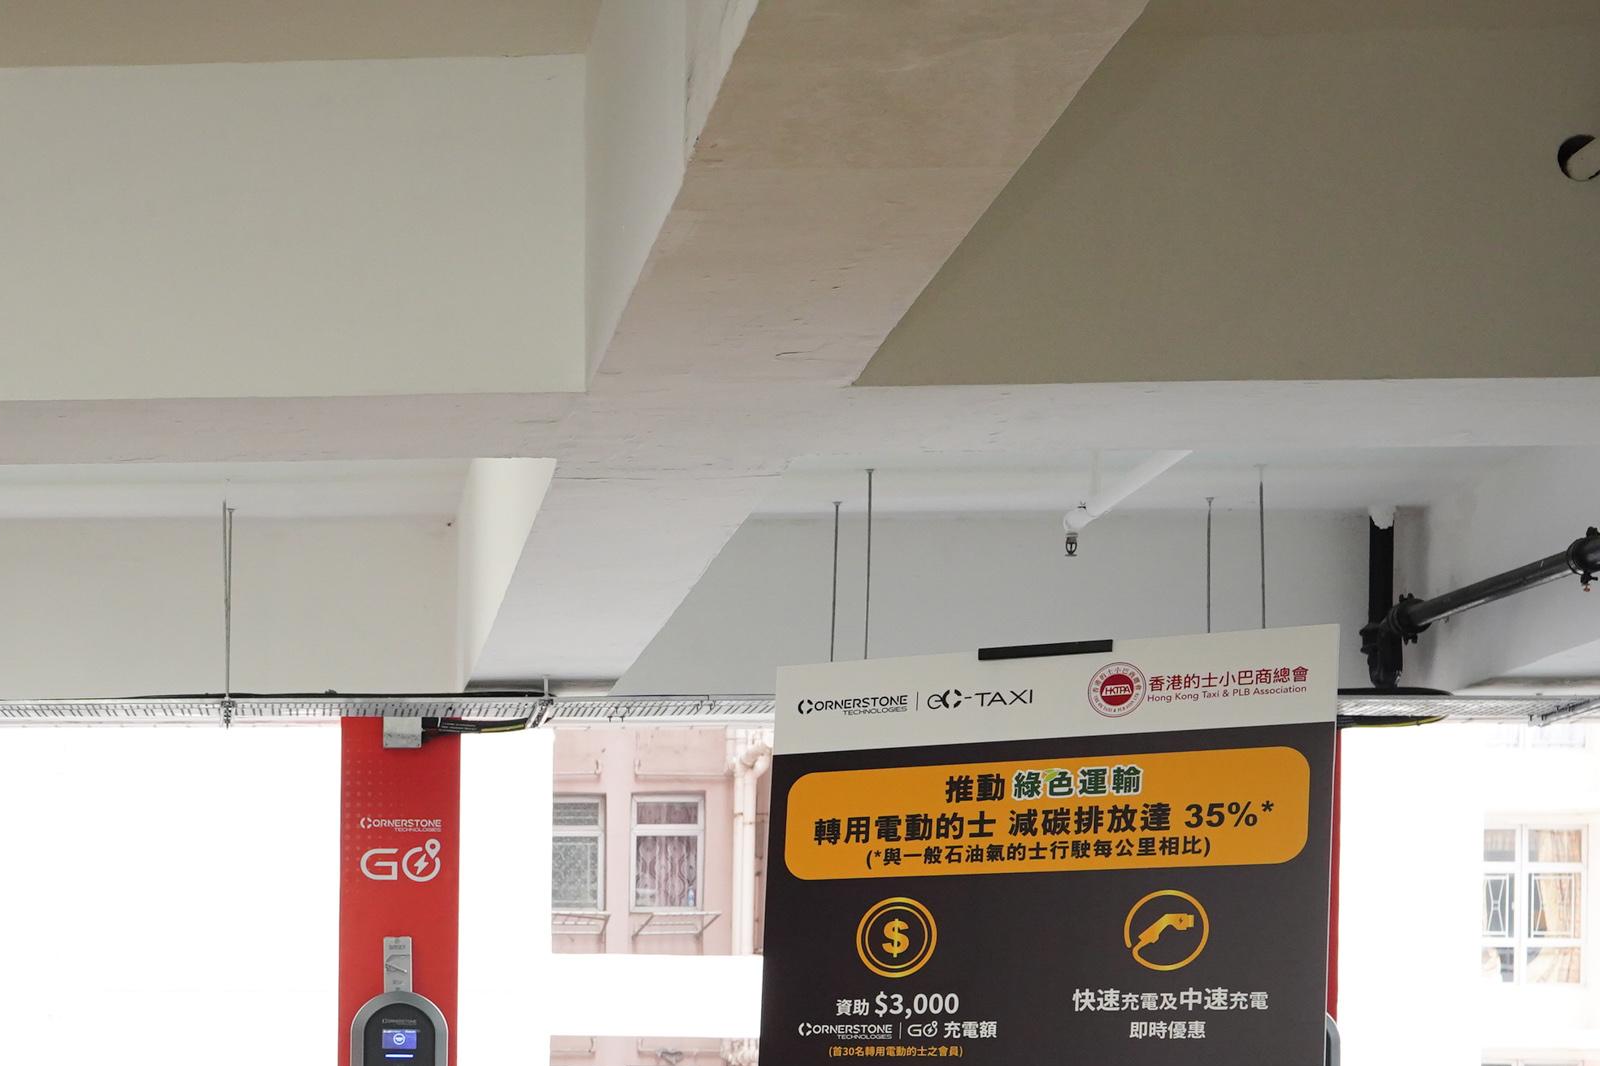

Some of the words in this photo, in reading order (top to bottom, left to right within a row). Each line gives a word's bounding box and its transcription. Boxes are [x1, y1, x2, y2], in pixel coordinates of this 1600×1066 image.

[1149, 666, 1309, 692] 香港的士小巴商總會
[798, 694, 908, 714] CORNERSTONE
[1147, 693, 1172, 703] Hong
[1175, 692, 1199, 702] Kong
[1202, 690, 1220, 699] Taxi
[1222, 688, 1229, 697] &
[1232, 687, 1250, 696] PLB
[1253, 685, 1307, 695] Association
[843, 706, 908, 716] TECHNOLOGIES
[945, 774, 1005, 803] 推動
[1012, 766, 1143, 799] 綠色運輸
[360, 817, 442, 829] CORNERSTONE
[814, 811, 997, 845] 轉用電動的士
[1008, 803, 1171, 836] 減碳排放達
[360, 838, 441, 882] GO
[836, 999, 869, 1016] 資助
[874, 991, 960, 1019] $3,000
[1072, 987, 1269, 1012] 快速充電及中速充電
[798, 1022, 893, 1037] CORNERSTONE
[943, 1020, 997, 1038] 充電額
[1129, 1020, 1206, 1039] 即時優惠
